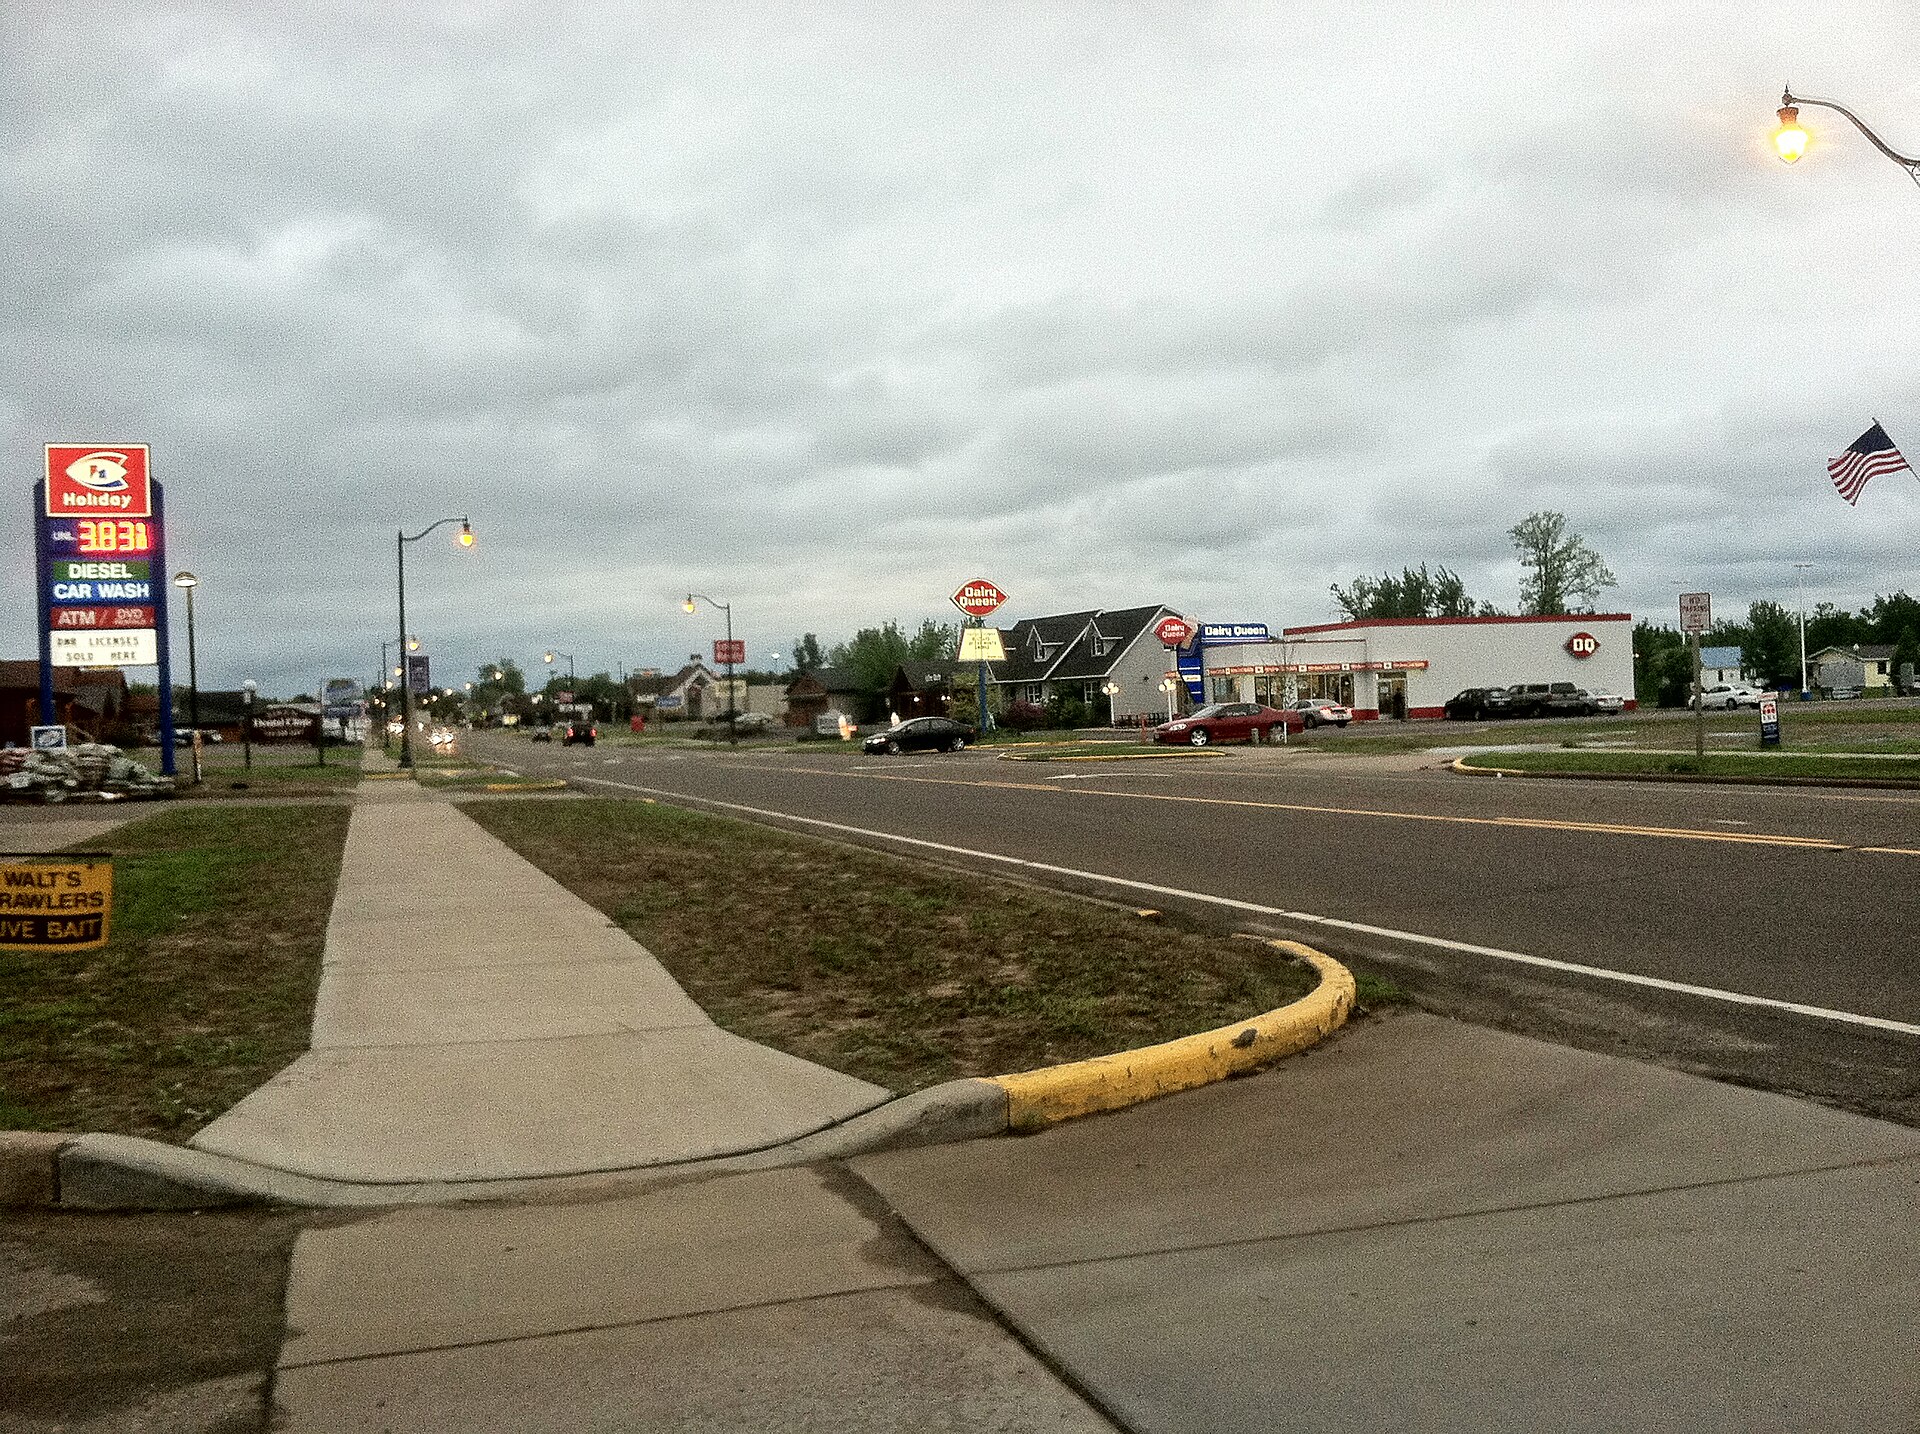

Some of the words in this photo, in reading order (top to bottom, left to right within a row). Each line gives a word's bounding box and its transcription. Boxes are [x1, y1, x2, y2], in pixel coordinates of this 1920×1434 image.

[63, 492, 132, 509] Holiday
[69, 563, 132, 579] DIESEL
[54, 583, 92, 599] CAR
[98, 583, 150, 599] WASH
[965, 586, 997, 598] Dairy
[959, 597, 998, 609] Queen
[58, 610, 96, 626] ATM
[1164, 623, 1185, 632] Dairy
[1204, 625, 1232, 637] Dairy
[1234, 625, 1266, 637] Queen
[1161, 631, 1186, 639] Queen
[88, 637, 139, 648] LICENSES
[1572, 638, 1596, 653] DQ
[66, 652, 94, 662] SOLD
[110, 651, 137, 662] HERE
[47, 919, 99, 940] BAIT
